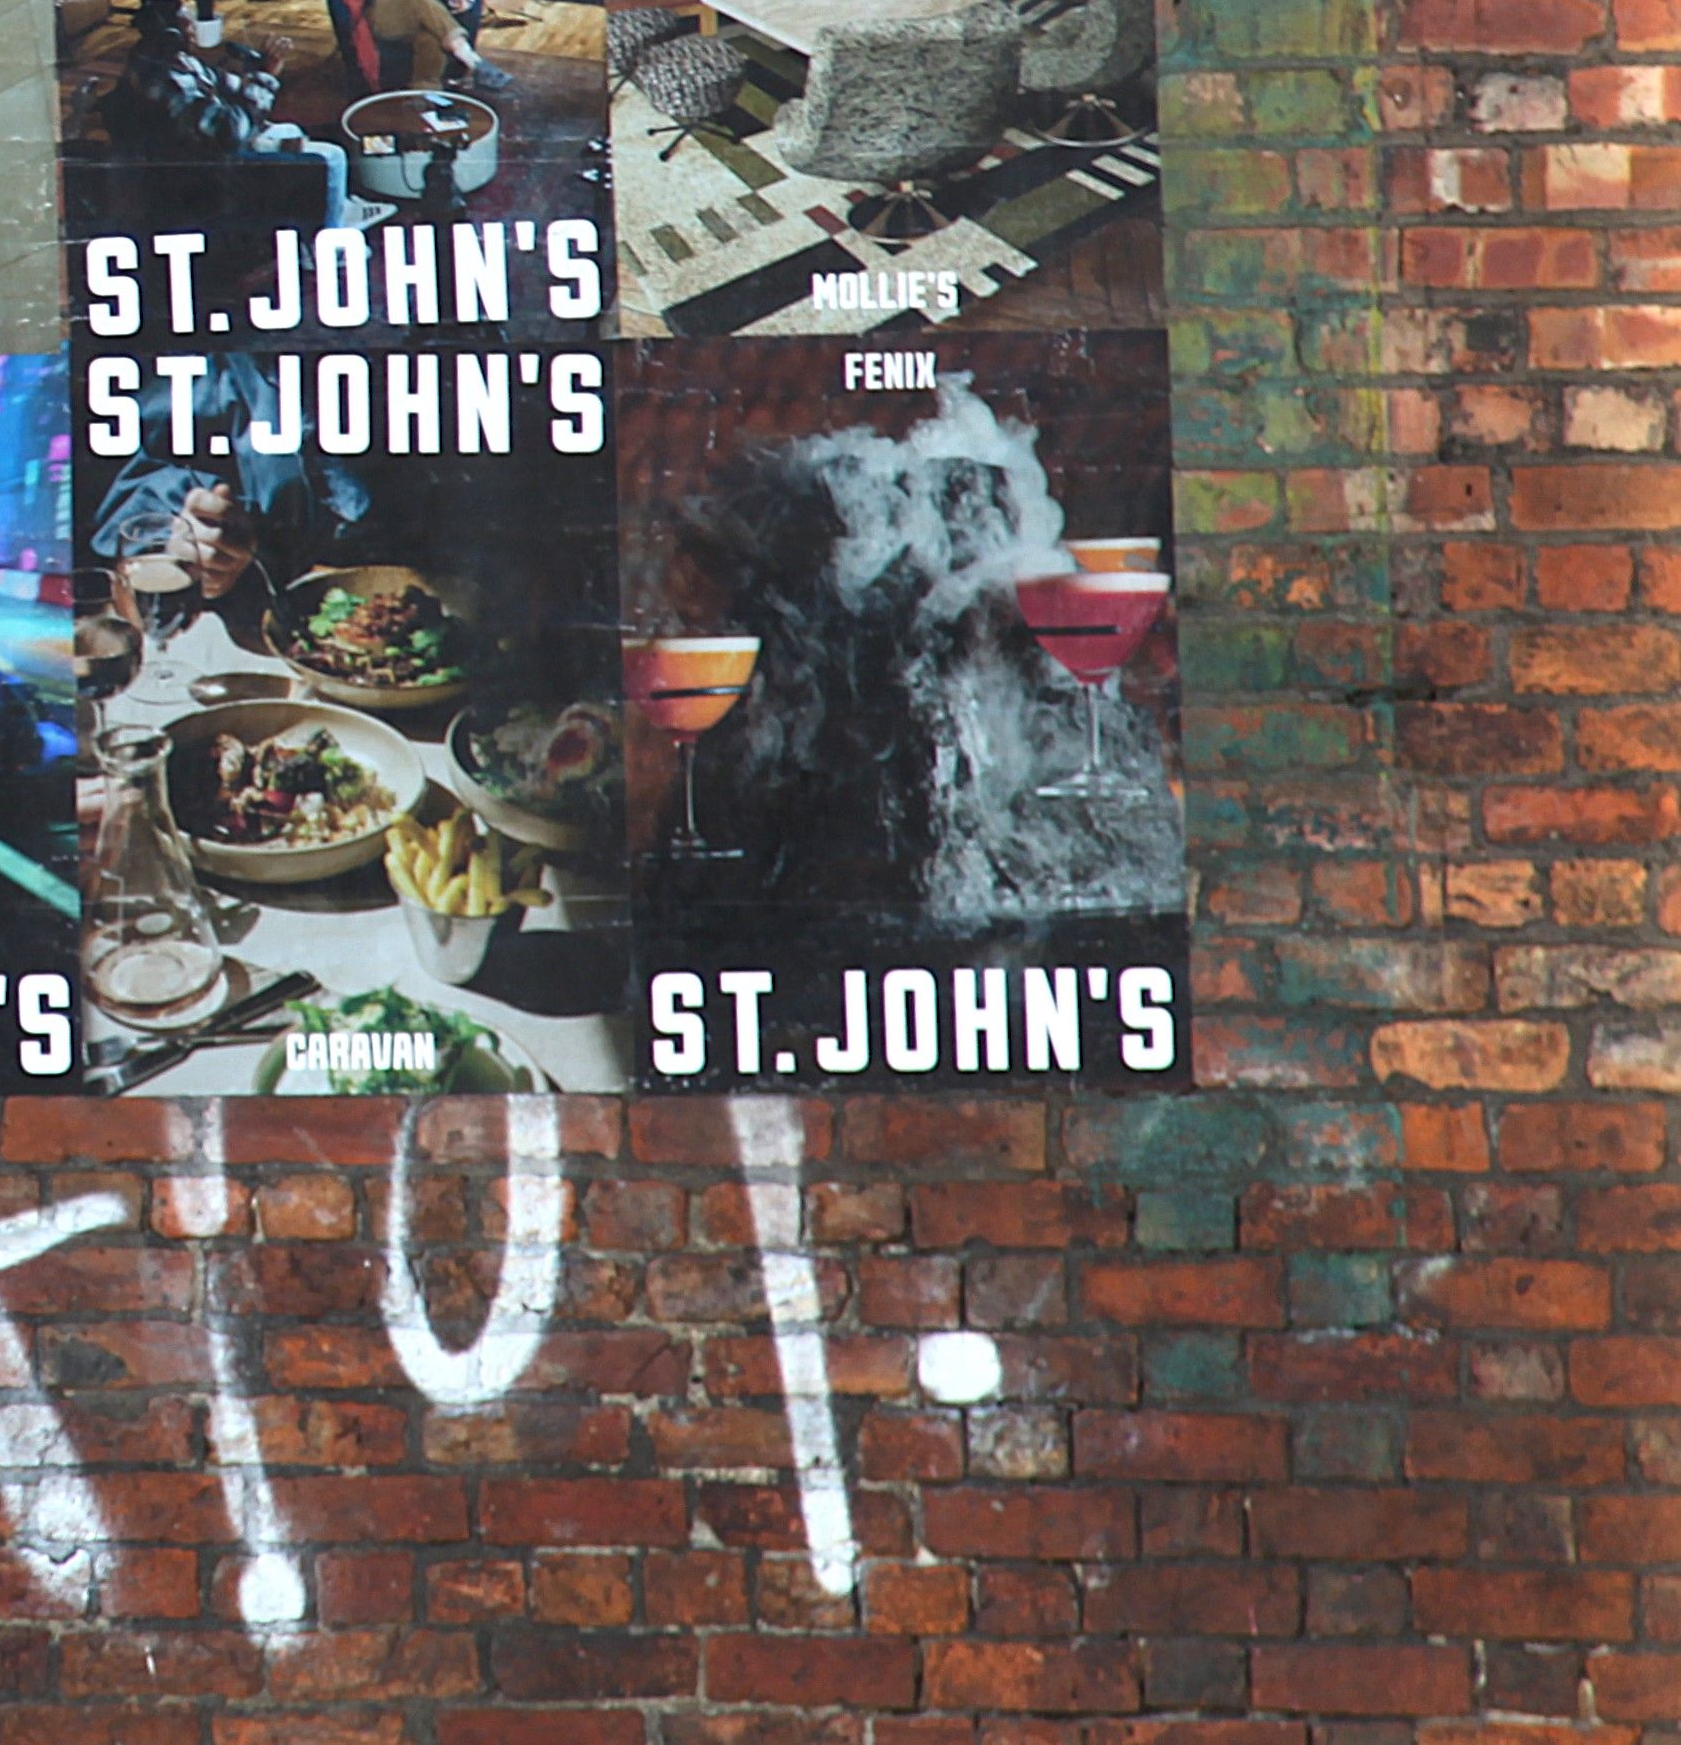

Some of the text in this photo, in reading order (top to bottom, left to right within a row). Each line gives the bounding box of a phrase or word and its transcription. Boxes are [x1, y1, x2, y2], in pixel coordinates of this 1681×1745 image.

[812, 270, 959, 310] MOLLIE'S
[844, 351, 936, 390] FENIX
[287, 1032, 436, 1071] CARAVAN
